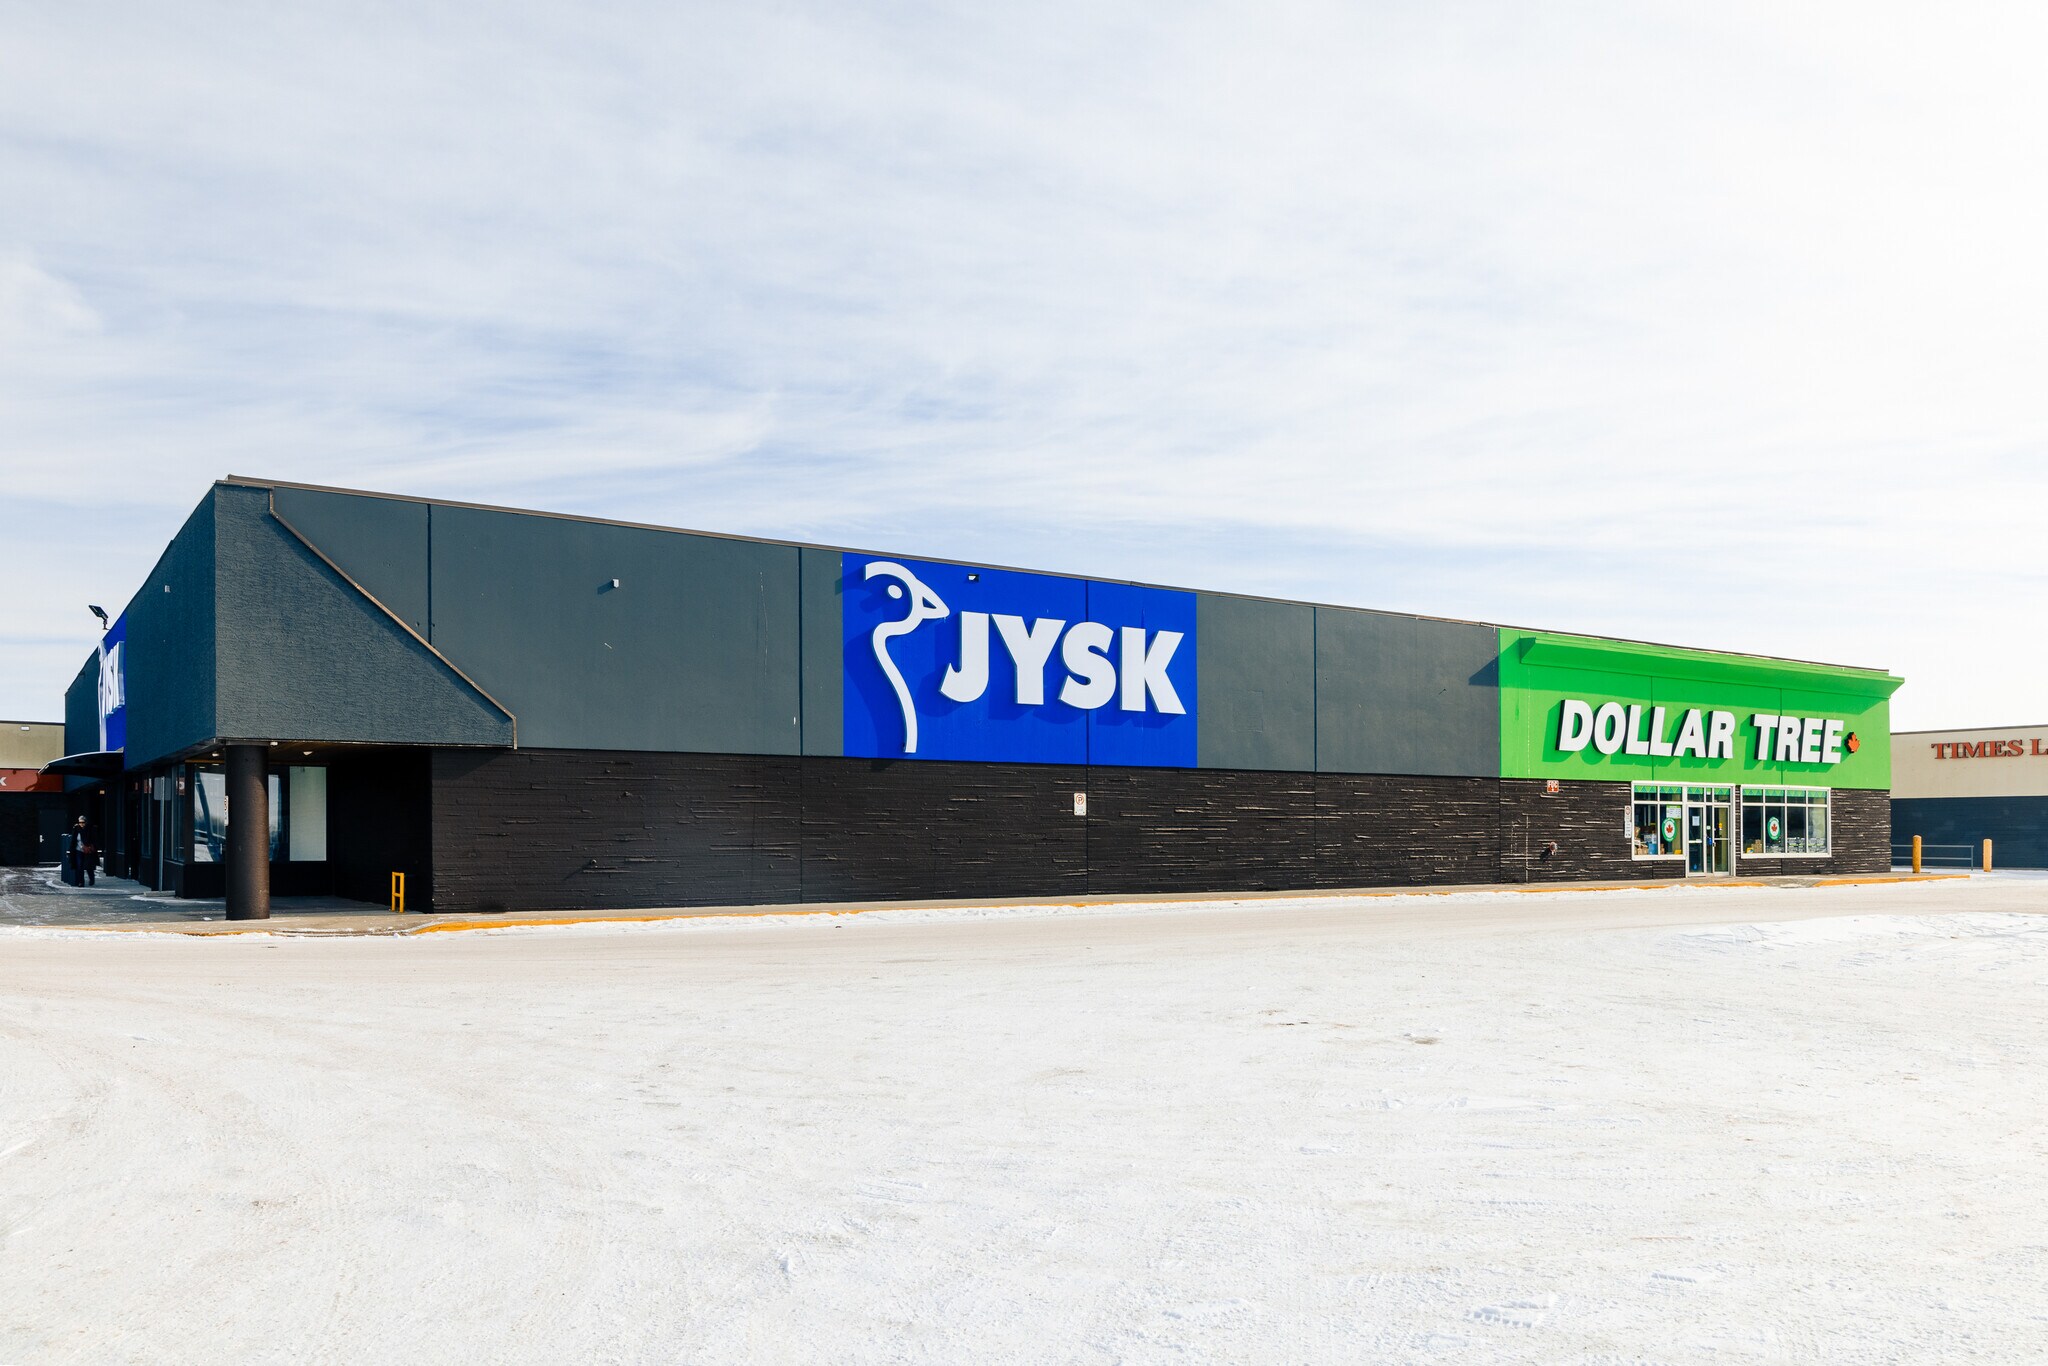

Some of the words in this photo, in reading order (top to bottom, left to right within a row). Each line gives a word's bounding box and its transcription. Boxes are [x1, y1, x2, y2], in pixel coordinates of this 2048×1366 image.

[940, 611, 1187, 715] JYSK
[1556, 699, 1736, 760] DOLLAR
[1750, 713, 1844, 764] TREE
[1931, 739, 2024, 760] TIMES
